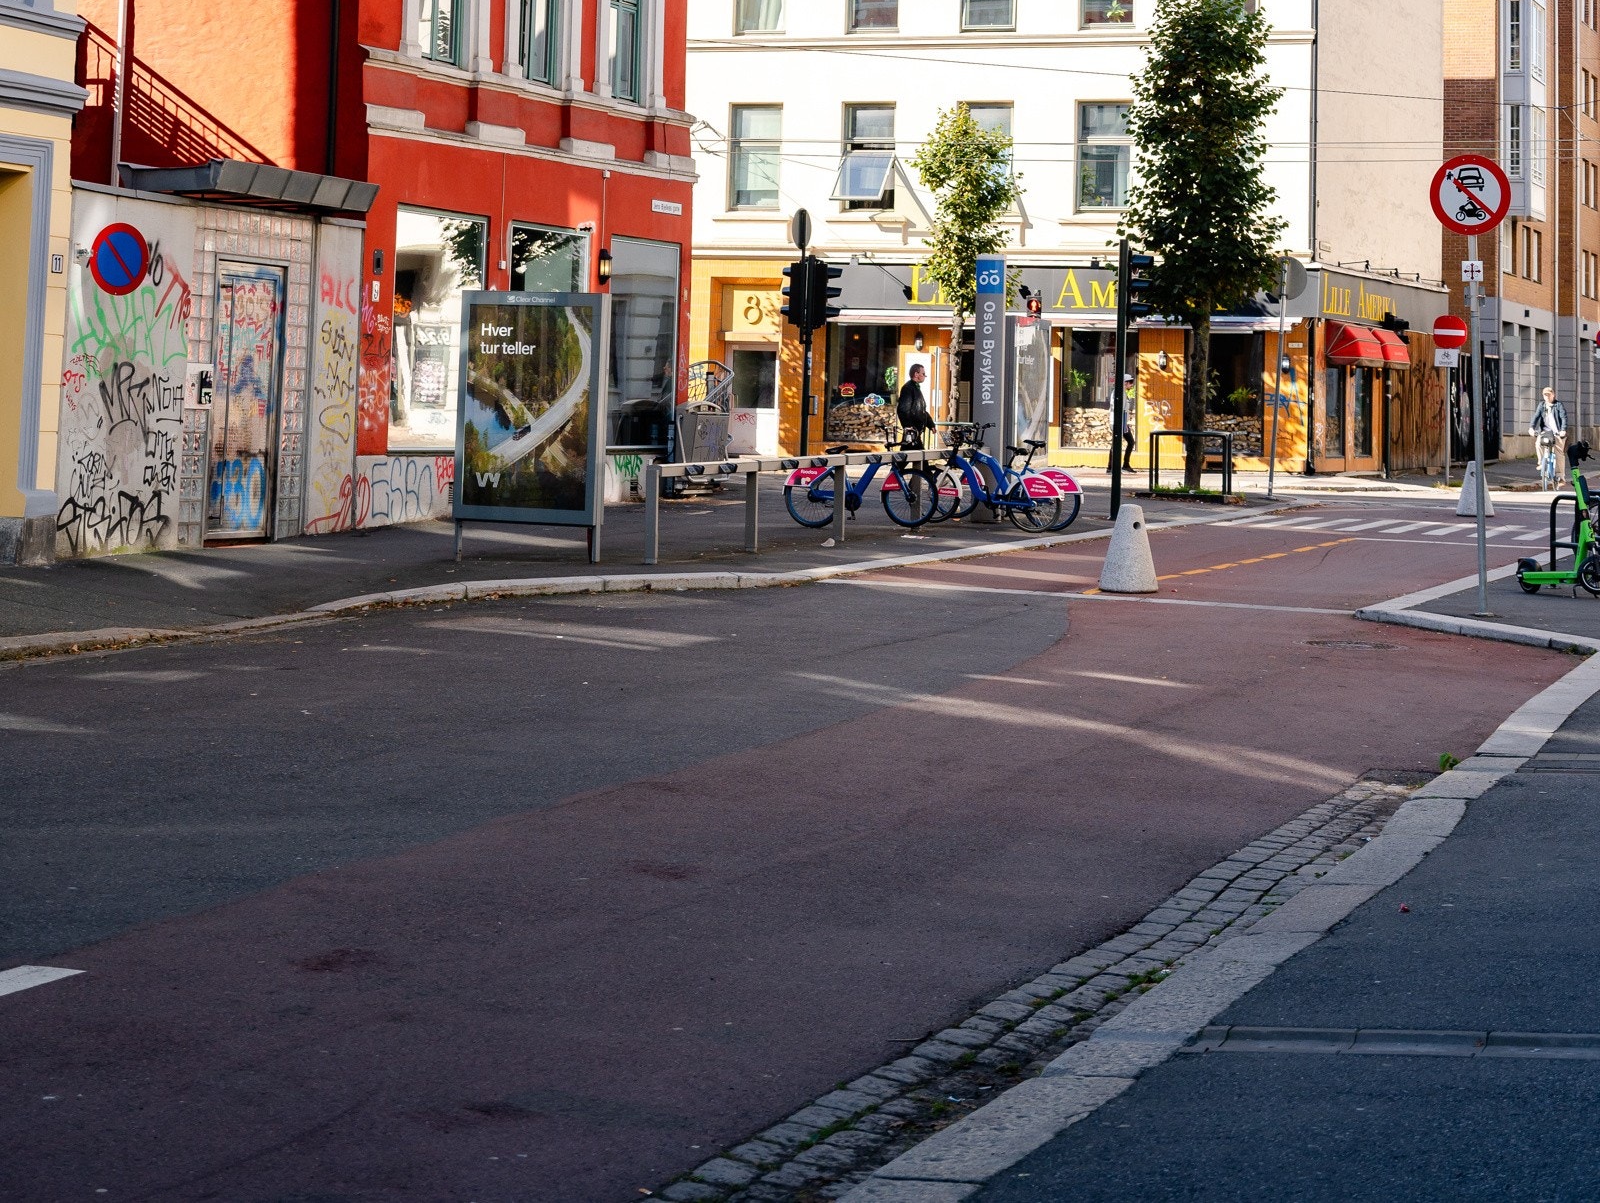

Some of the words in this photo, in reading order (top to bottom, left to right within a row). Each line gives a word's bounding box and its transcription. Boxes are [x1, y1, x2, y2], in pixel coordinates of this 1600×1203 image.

[54, 257, 61, 271] 11
[744, 294, 764, 325] 8
[1322, 272, 1351, 316] LILLE
[1357, 279, 1397, 322] AMERIKA
[481, 323, 514, 337] Hver
[983, 301, 996, 335] Oslo
[480, 342, 498, 355] tur
[502, 341, 536, 355] teller
[980, 339, 995, 405] Bysykkel
